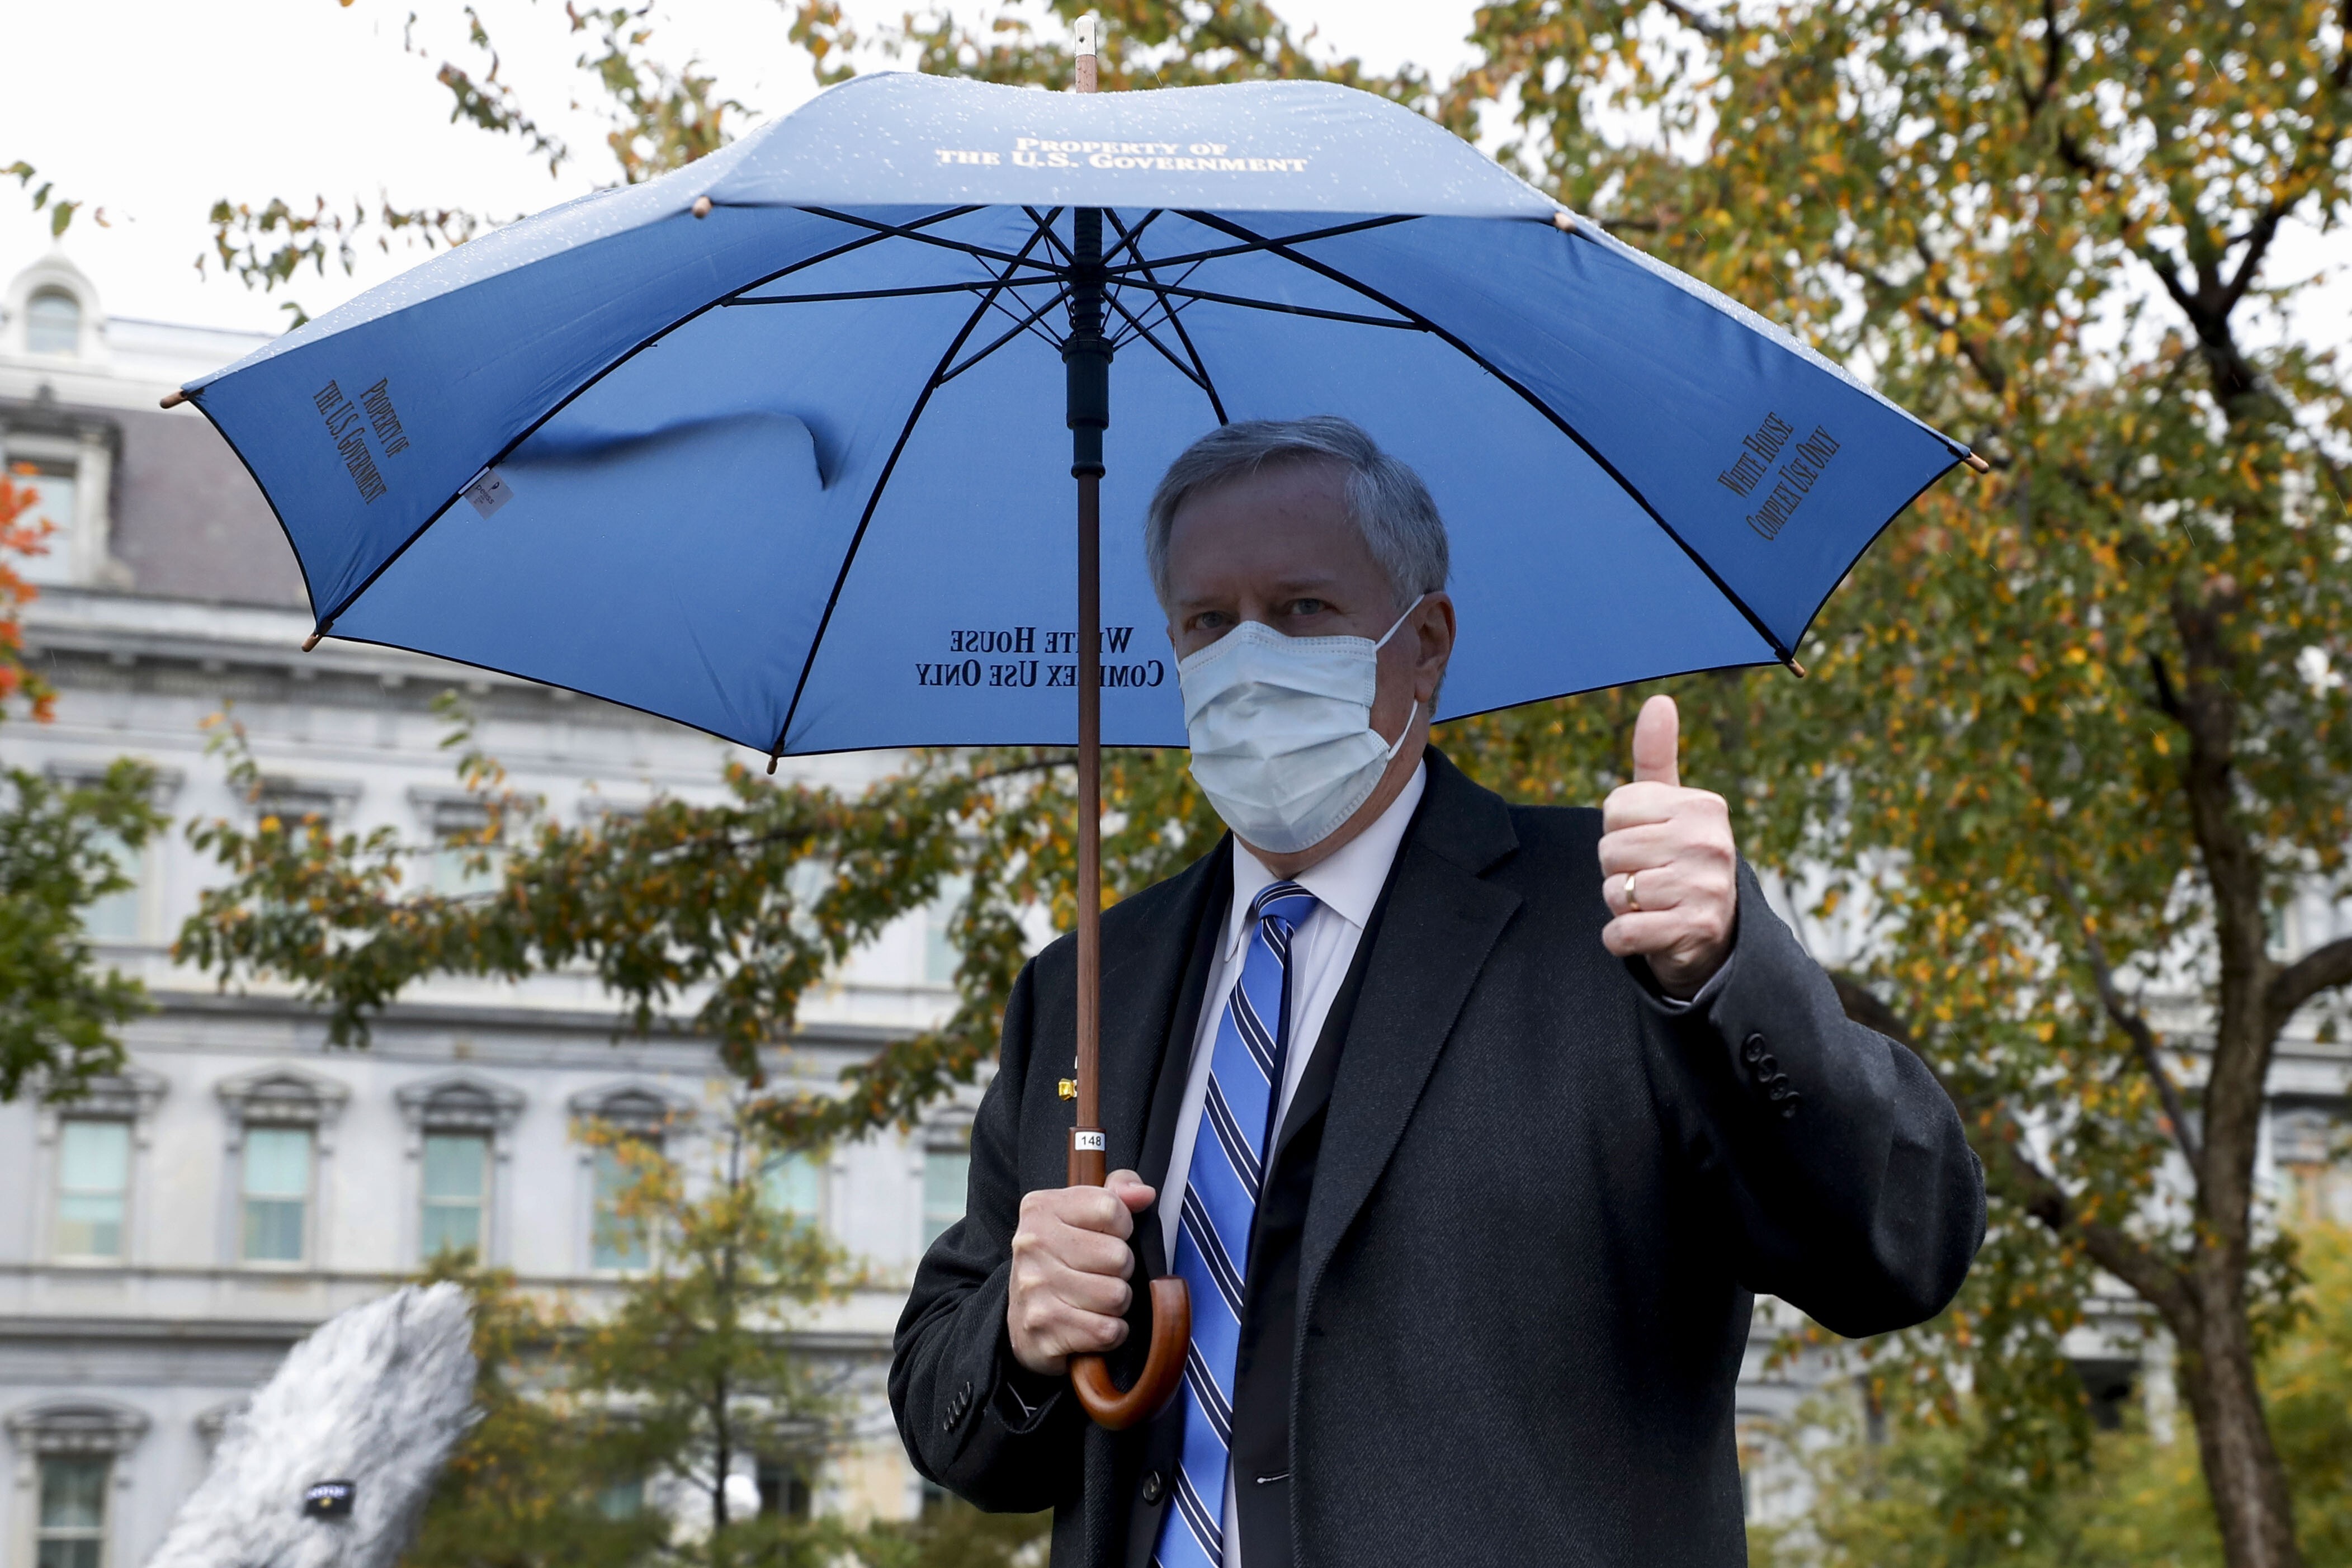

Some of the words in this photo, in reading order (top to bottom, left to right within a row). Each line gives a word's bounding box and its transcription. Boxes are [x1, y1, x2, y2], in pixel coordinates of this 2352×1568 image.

[935, 149, 1001, 166] THE
[1011, 150, 1080, 168] U.S.
[1088, 152, 1308, 173] GOVERNMENT
[1016, 136, 1180, 155] PROPERTY
[1189, 143, 1229, 157] OF
[313, 379, 343, 415] THE
[325, 400, 360, 440] U.S.
[360, 377, 403, 445] PROPERTY
[385, 436, 410, 458] OF
[337, 427, 387, 505] GOVERNMENT
[1717, 451, 1767, 499] WHITE
[1742, 411, 1794, 464] HOUSE
[1796, 425, 1840, 469] ONLY
[1778, 457, 1819, 493] USE
[1746, 481, 1802, 541] COMPLEX
[1081, 1136, 1102, 1146] 148
